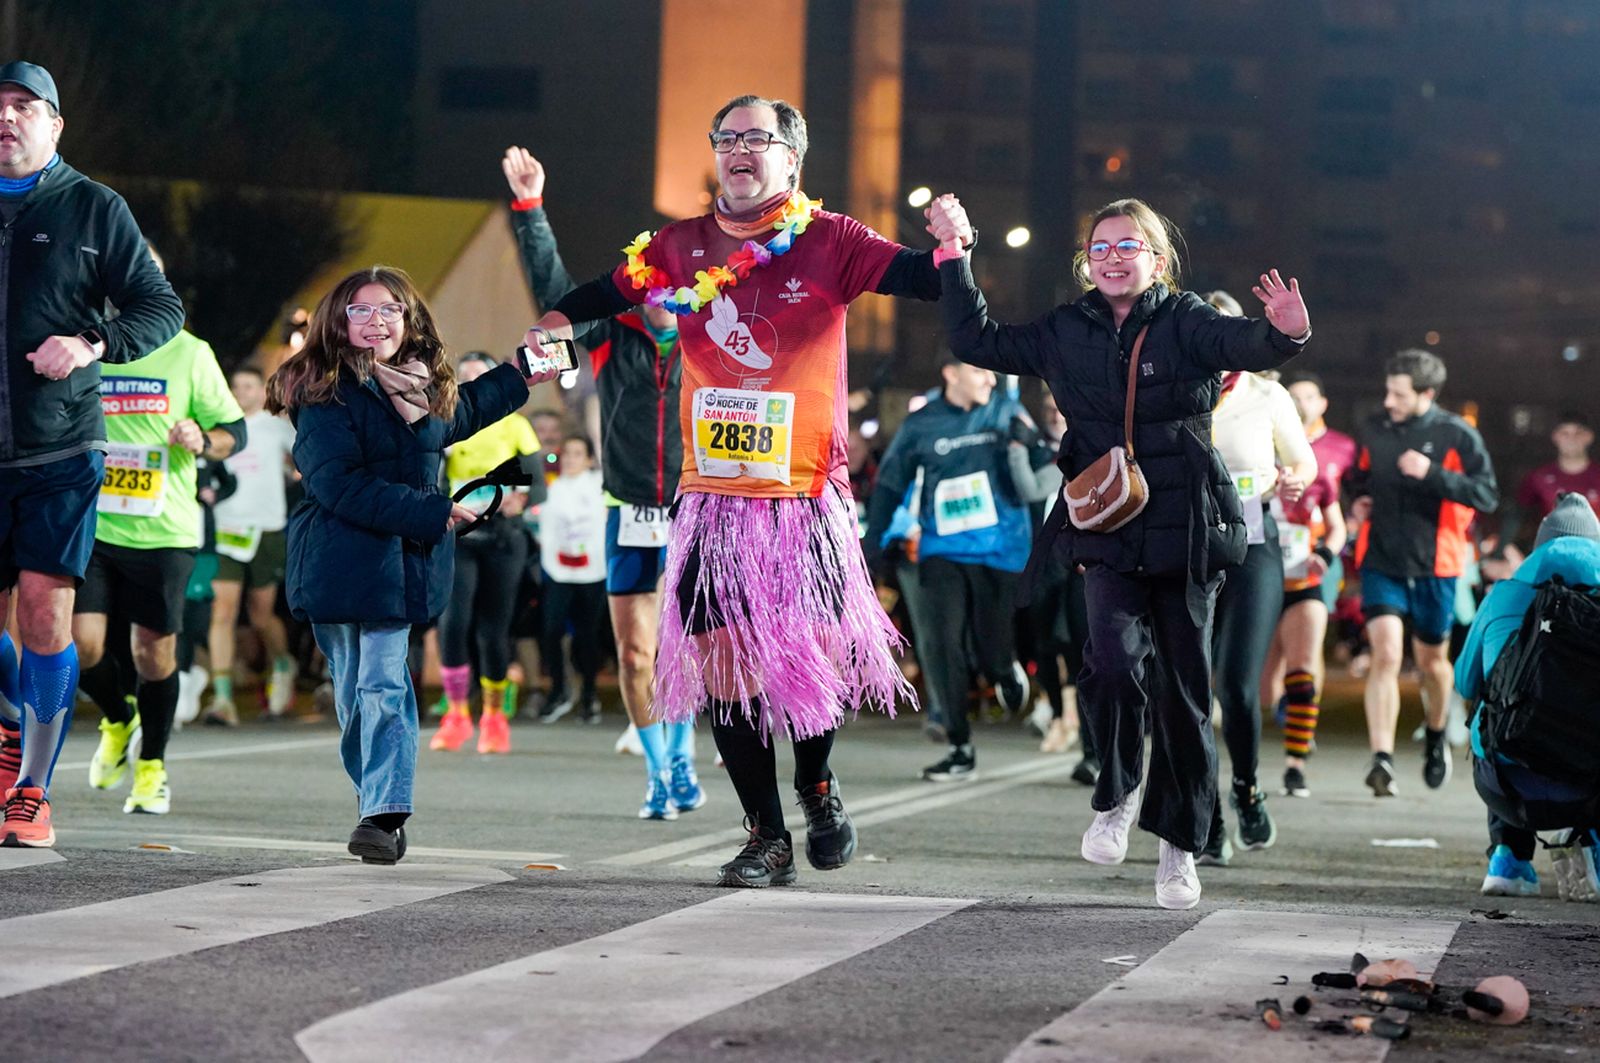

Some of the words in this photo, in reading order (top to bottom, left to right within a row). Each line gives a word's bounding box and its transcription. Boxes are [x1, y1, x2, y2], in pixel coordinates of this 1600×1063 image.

[724, 330, 750, 356] 43
[115, 381, 162, 394] RITMO
[101, 400, 120, 413] RO
[122, 399, 167, 411] LLEGO
[716, 399, 744, 409] NOCHE
[746, 401, 758, 411] DE
[704, 409, 722, 420] SAN
[724, 410, 758, 422] ANTÓN
[710, 422, 773, 453] 2838
[103, 467, 152, 491] 6233
[633, 504, 670, 523] 261
